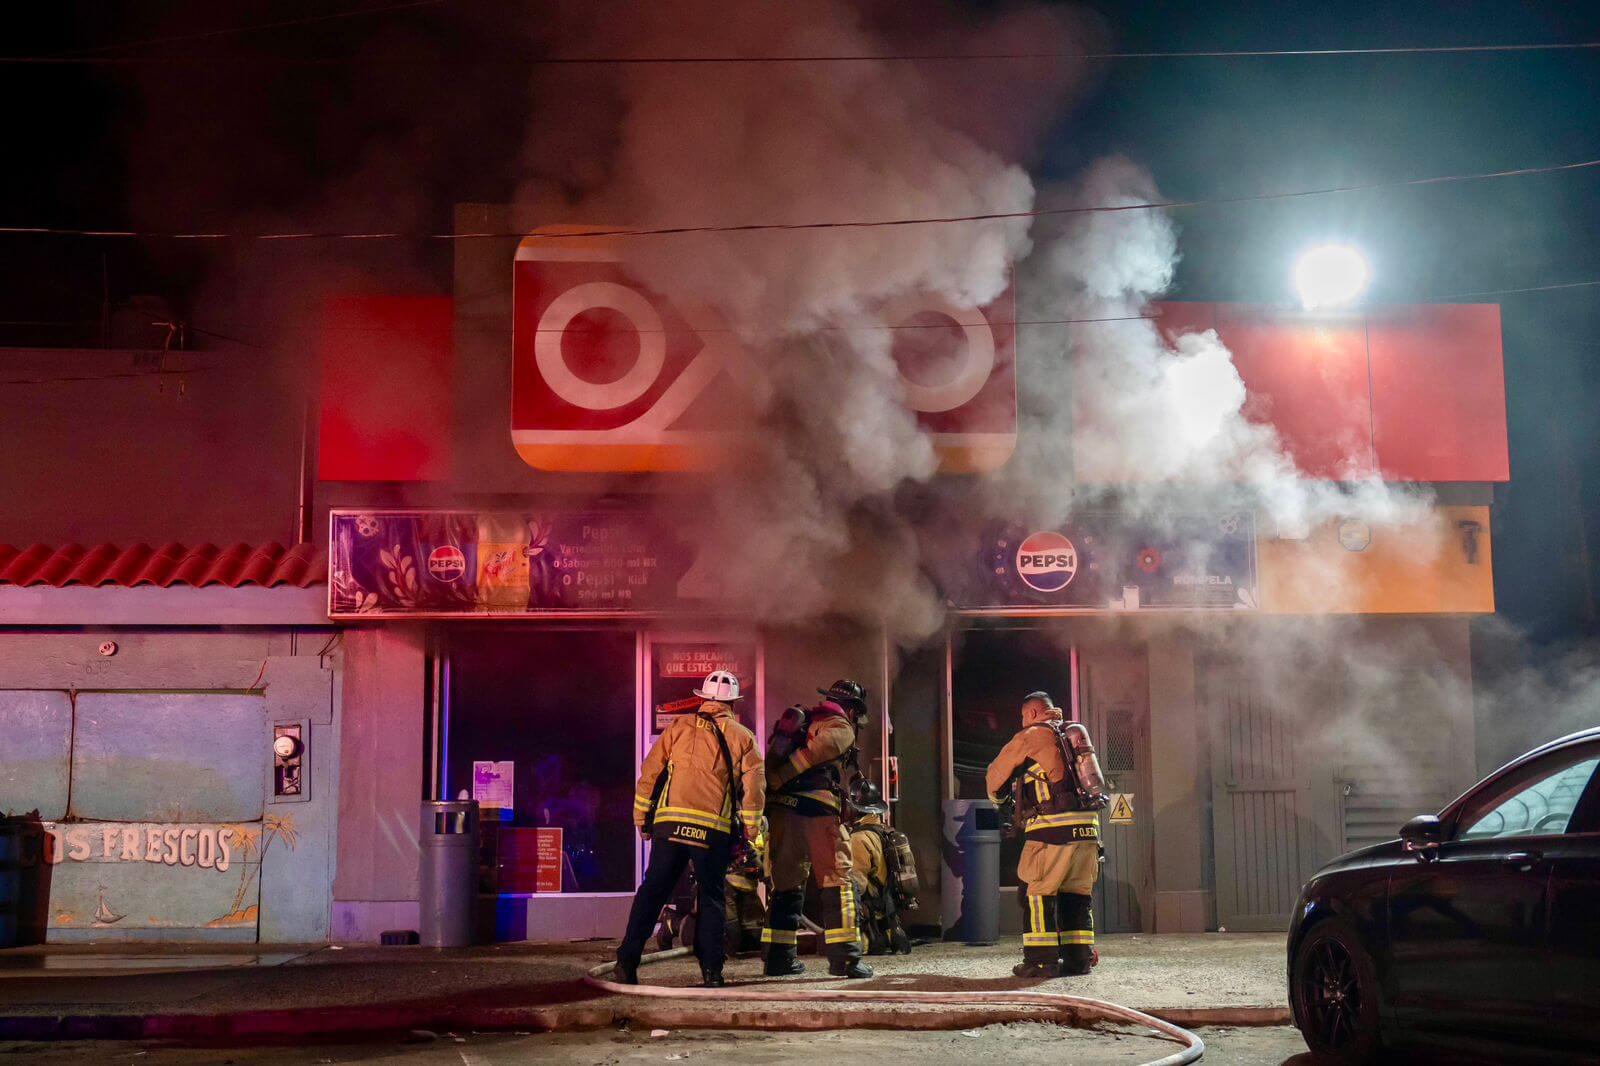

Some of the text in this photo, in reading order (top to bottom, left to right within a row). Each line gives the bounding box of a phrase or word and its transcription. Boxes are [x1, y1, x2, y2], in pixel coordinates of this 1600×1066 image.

[534, 280, 996, 428] OXO
[429, 559, 463, 568] PEPSI
[1020, 554, 1074, 568] PEPSI
[672, 652, 692, 661] NOS
[666, 663, 685, 674] QUE
[673, 826, 707, 840] J CERON
[1072, 827, 1078, 838] F
[102, 828, 234, 871] FRESCOS
